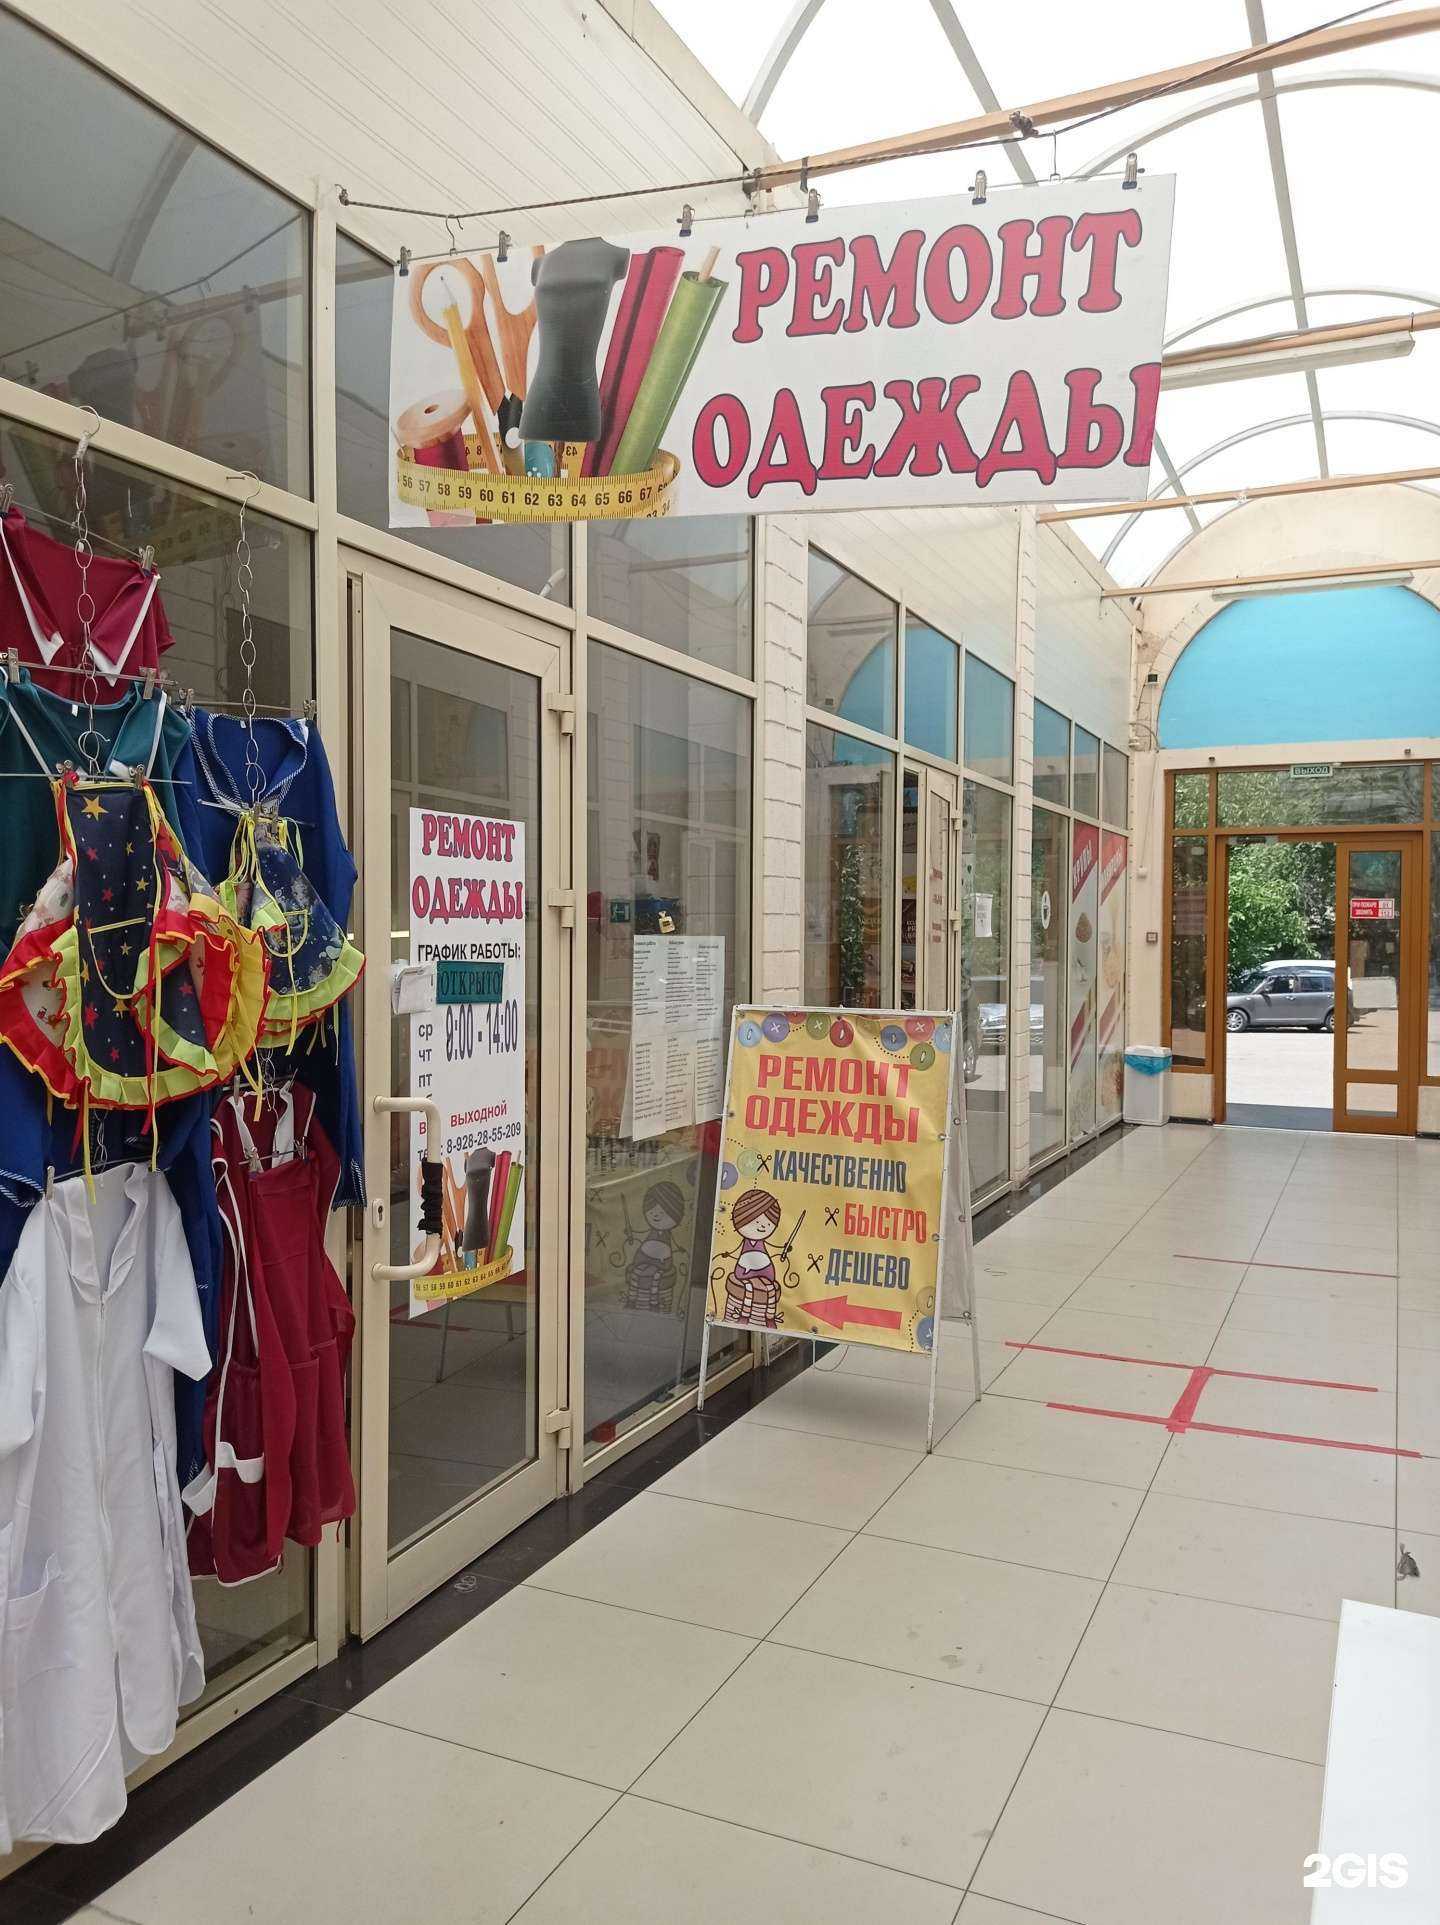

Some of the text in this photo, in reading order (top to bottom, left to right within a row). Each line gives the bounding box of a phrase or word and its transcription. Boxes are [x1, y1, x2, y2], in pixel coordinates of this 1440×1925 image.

[732, 208, 1142, 344] РЕМОНТ
[692, 362, 1163, 498] ОДЕЖДЫ
[419, 479, 431, 493] 57
[437, 483, 451, 496] 58
[458, 486, 472, 499] 59
[479, 489, 494, 502] 60
[501, 491, 515, 504] 61
[524, 492, 539, 505] 62
[547, 494, 563, 507] 63
[571, 494, 586, 507] 64
[595, 492, 610, 505] 65
[618, 490, 633, 503] 66
[640, 486, 653, 500] 67
[1294, 766, 1329, 775] ВЫХОД
[421, 813, 516, 862] РЕМОНТ
[412, 875, 524, 925] ОДЕЖДЫ
[418, 943, 521, 961] ГРАФИК РАБОТЫ:
[440, 970, 501, 996] ОТКРЫТО
[487, 999, 518, 1055] 14:00
[418, 1049, 432, 1062] чт
[757, 1054, 917, 1098] РЕМОНТ
[418, 1074, 432, 1088] пт
[446, 1121, 521, 1154] 8-928-28-55-209
[745, 1095, 920, 1145] ОДЕЖДЫ
[772, 1150, 907, 1194] КАЧЕСТВЕННО
[844, 1203, 927, 1244] БЫСТРО
[825, 1248, 911, 1290] ДЕШЕВО
